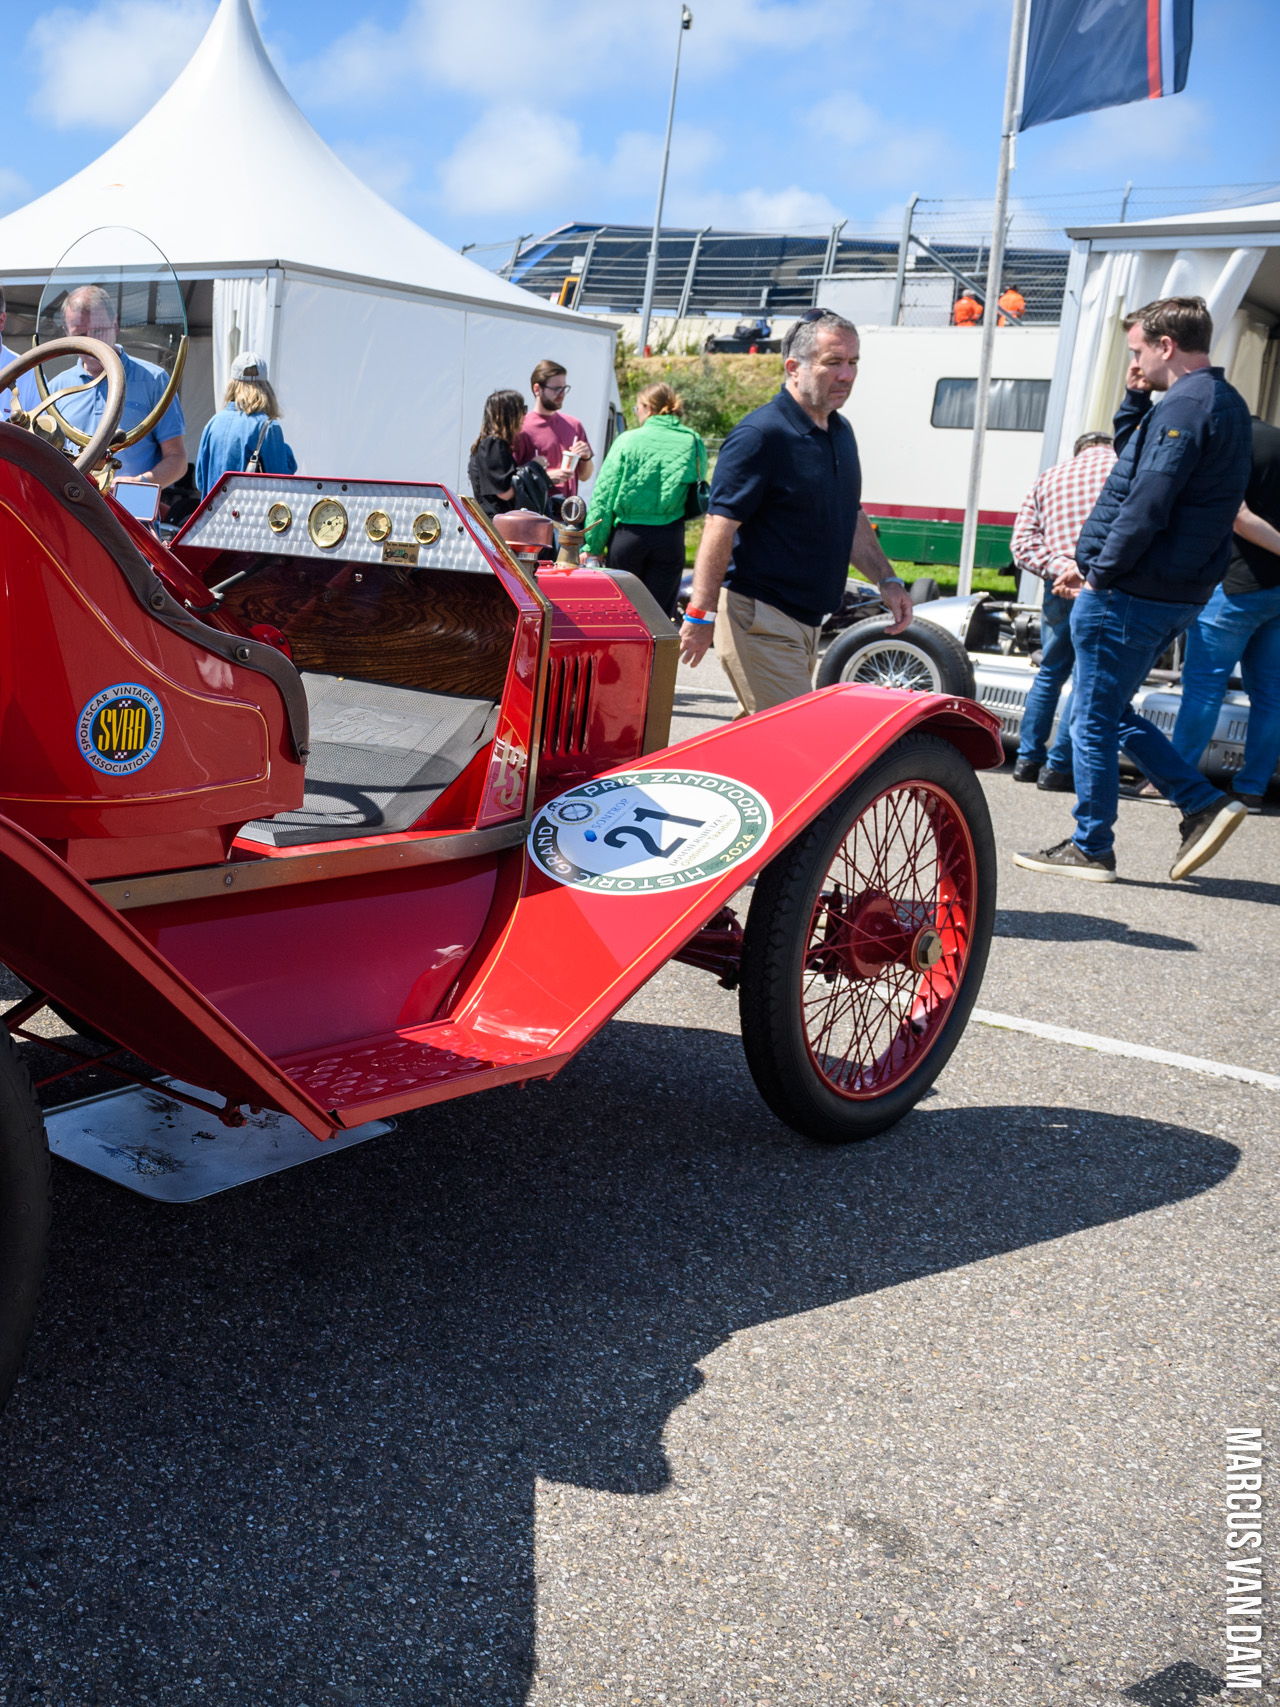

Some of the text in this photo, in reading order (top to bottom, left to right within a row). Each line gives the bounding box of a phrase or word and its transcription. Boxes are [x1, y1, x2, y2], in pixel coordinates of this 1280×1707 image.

[81, 687, 161, 772] SPORTSCAR VINTAGE RACING ASSOCIATION
[98, 708, 146, 751] SVRA
[492, 727, 525, 806] 13
[586, 774, 642, 797] PRIX
[591, 798, 630, 829] SONTROP
[650, 773, 762, 825] ZANDVOORT
[538, 825, 573, 875] GRAND
[603, 807, 707, 859] 21
[719, 833, 756, 864] 2024
[573, 867, 706, 890] HISTORIC
